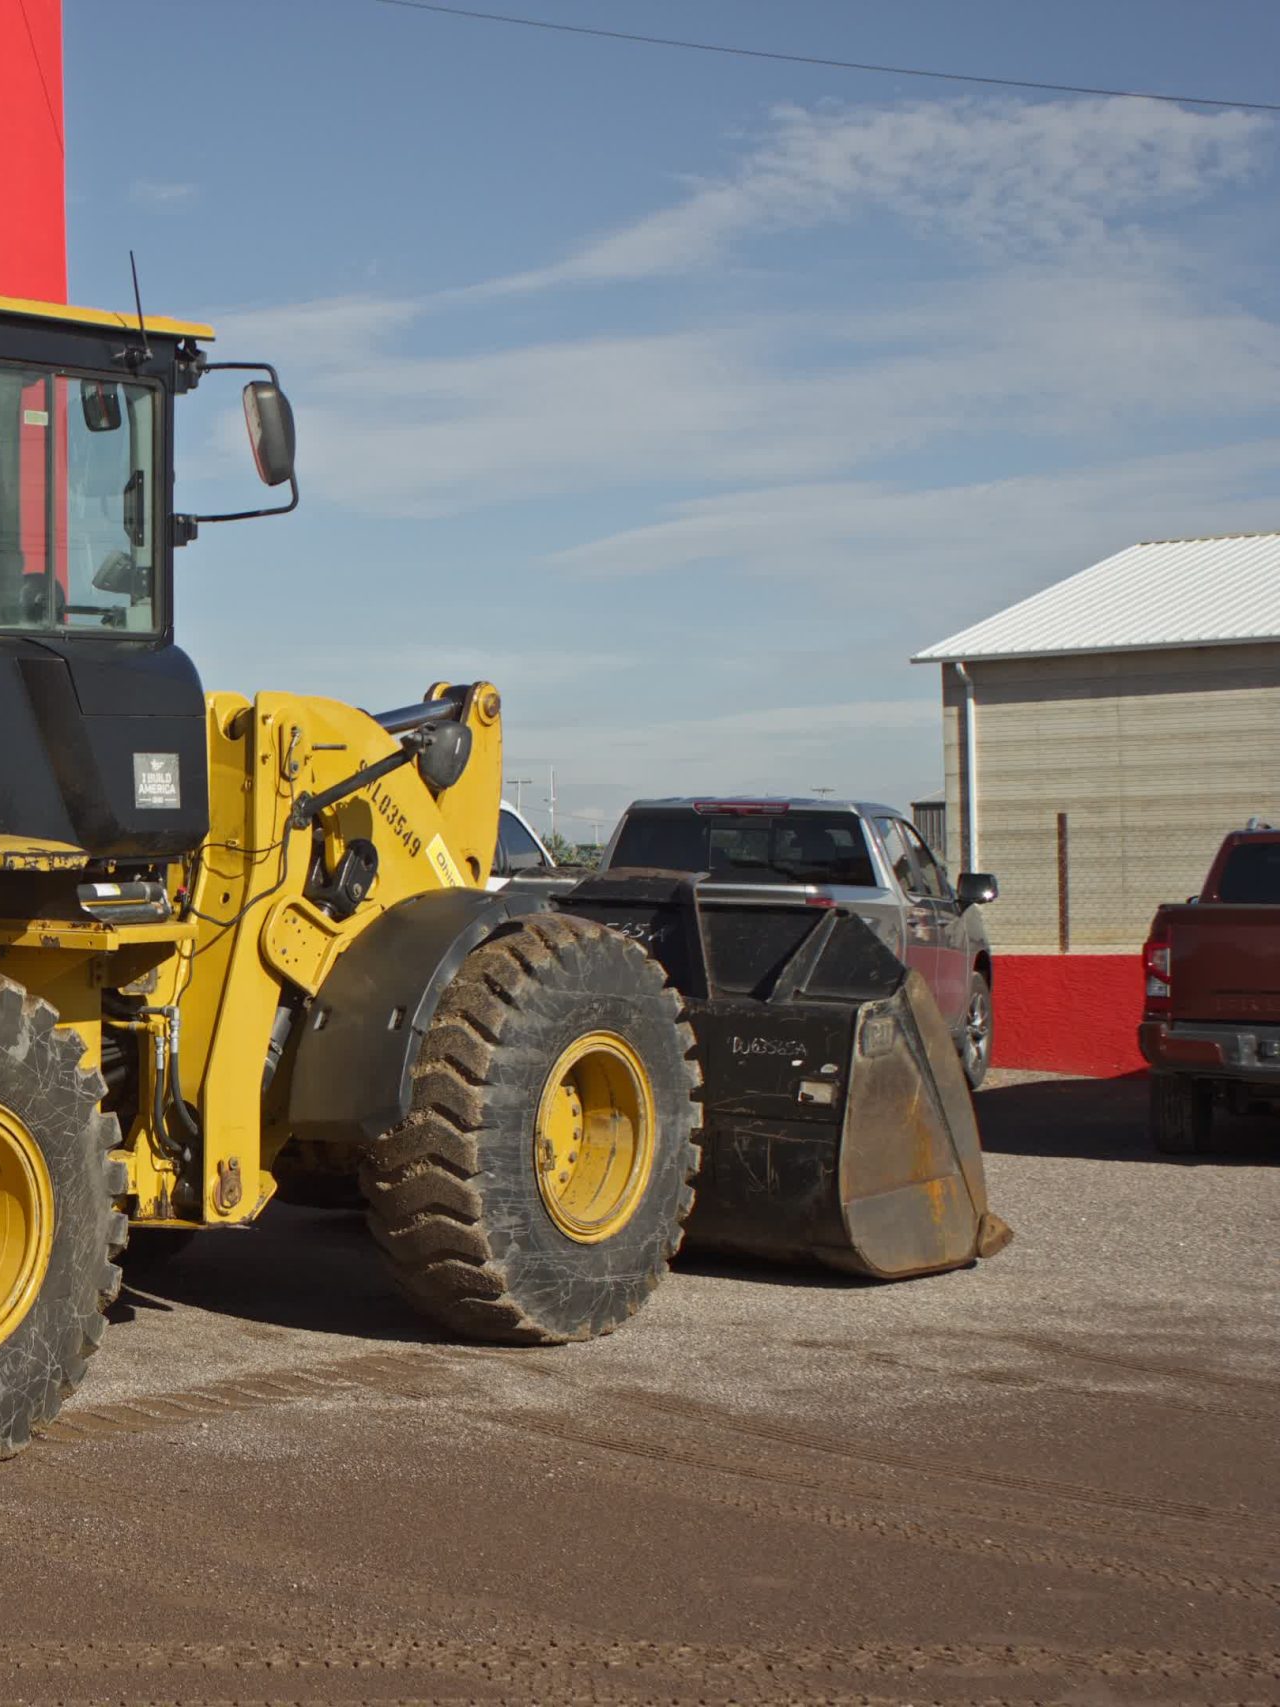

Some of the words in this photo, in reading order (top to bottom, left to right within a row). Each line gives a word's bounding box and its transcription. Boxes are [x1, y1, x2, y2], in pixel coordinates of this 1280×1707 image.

[141, 772, 146, 784] I
[147, 772, 172, 784] BUILD
[138, 783, 176, 795] AMERICA
